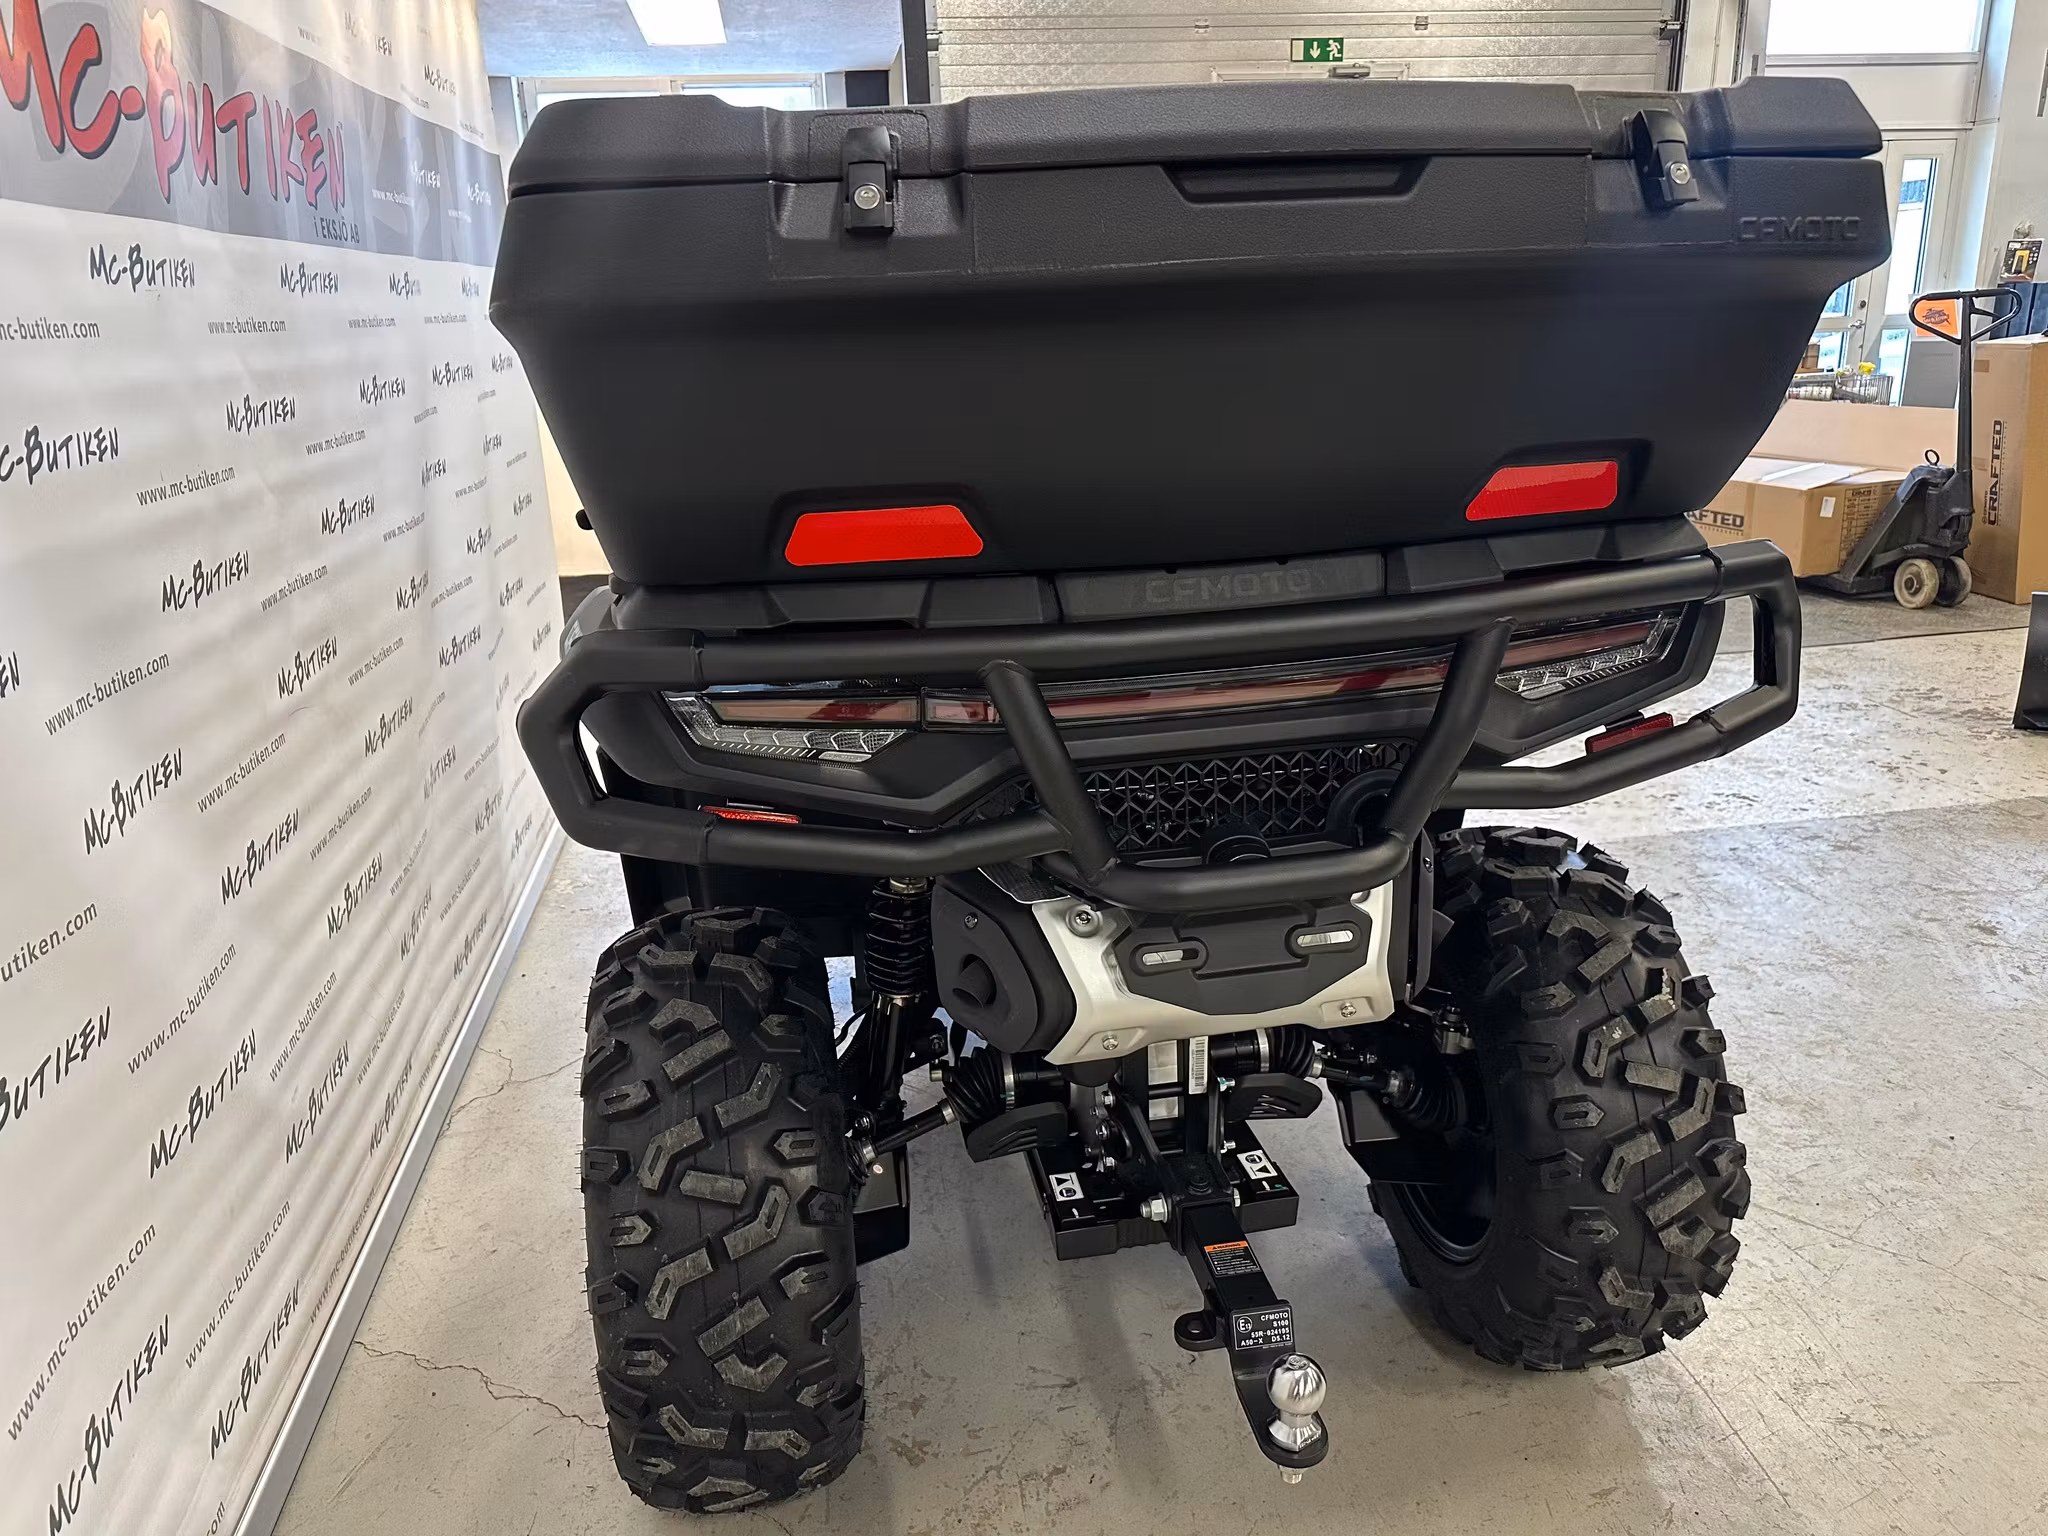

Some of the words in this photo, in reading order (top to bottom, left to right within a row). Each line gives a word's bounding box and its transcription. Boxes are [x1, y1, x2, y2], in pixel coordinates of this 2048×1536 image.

[320, 216, 349, 243] EKSJÖ
[349, 223, 360, 244] AB
[1739, 215, 1862, 242] CFMOTO
[208, 316, 286, 335] www.mc-butiken.com
[306, 429, 367, 456] www.mc-butiken.com
[136, 465, 236, 506] www.mc-butiken.com
[1987, 420, 2003, 526] CRAFTED
[260, 564, 329, 612] www.mc-butiken.com
[1144, 568, 1313, 603] CFMOTO
[347, 636, 405, 687] www.mc-butiken.com
[44, 653, 170, 736] www.mc-butiken.com
[197, 731, 287, 813] www.mc-butiken.com
[309, 786, 373, 862] www.mc-butiken.com
[126, 943, 238, 1076] www.mc-butiken.com
[269, 971, 338, 1083] www.mc-butiken.com
[184, 1200, 291, 1370] www.mc-butiken.com
[7, 1223, 157, 1441] www.mc-butiken.com
[1260, 1312, 1289, 1321] CFMOTO
